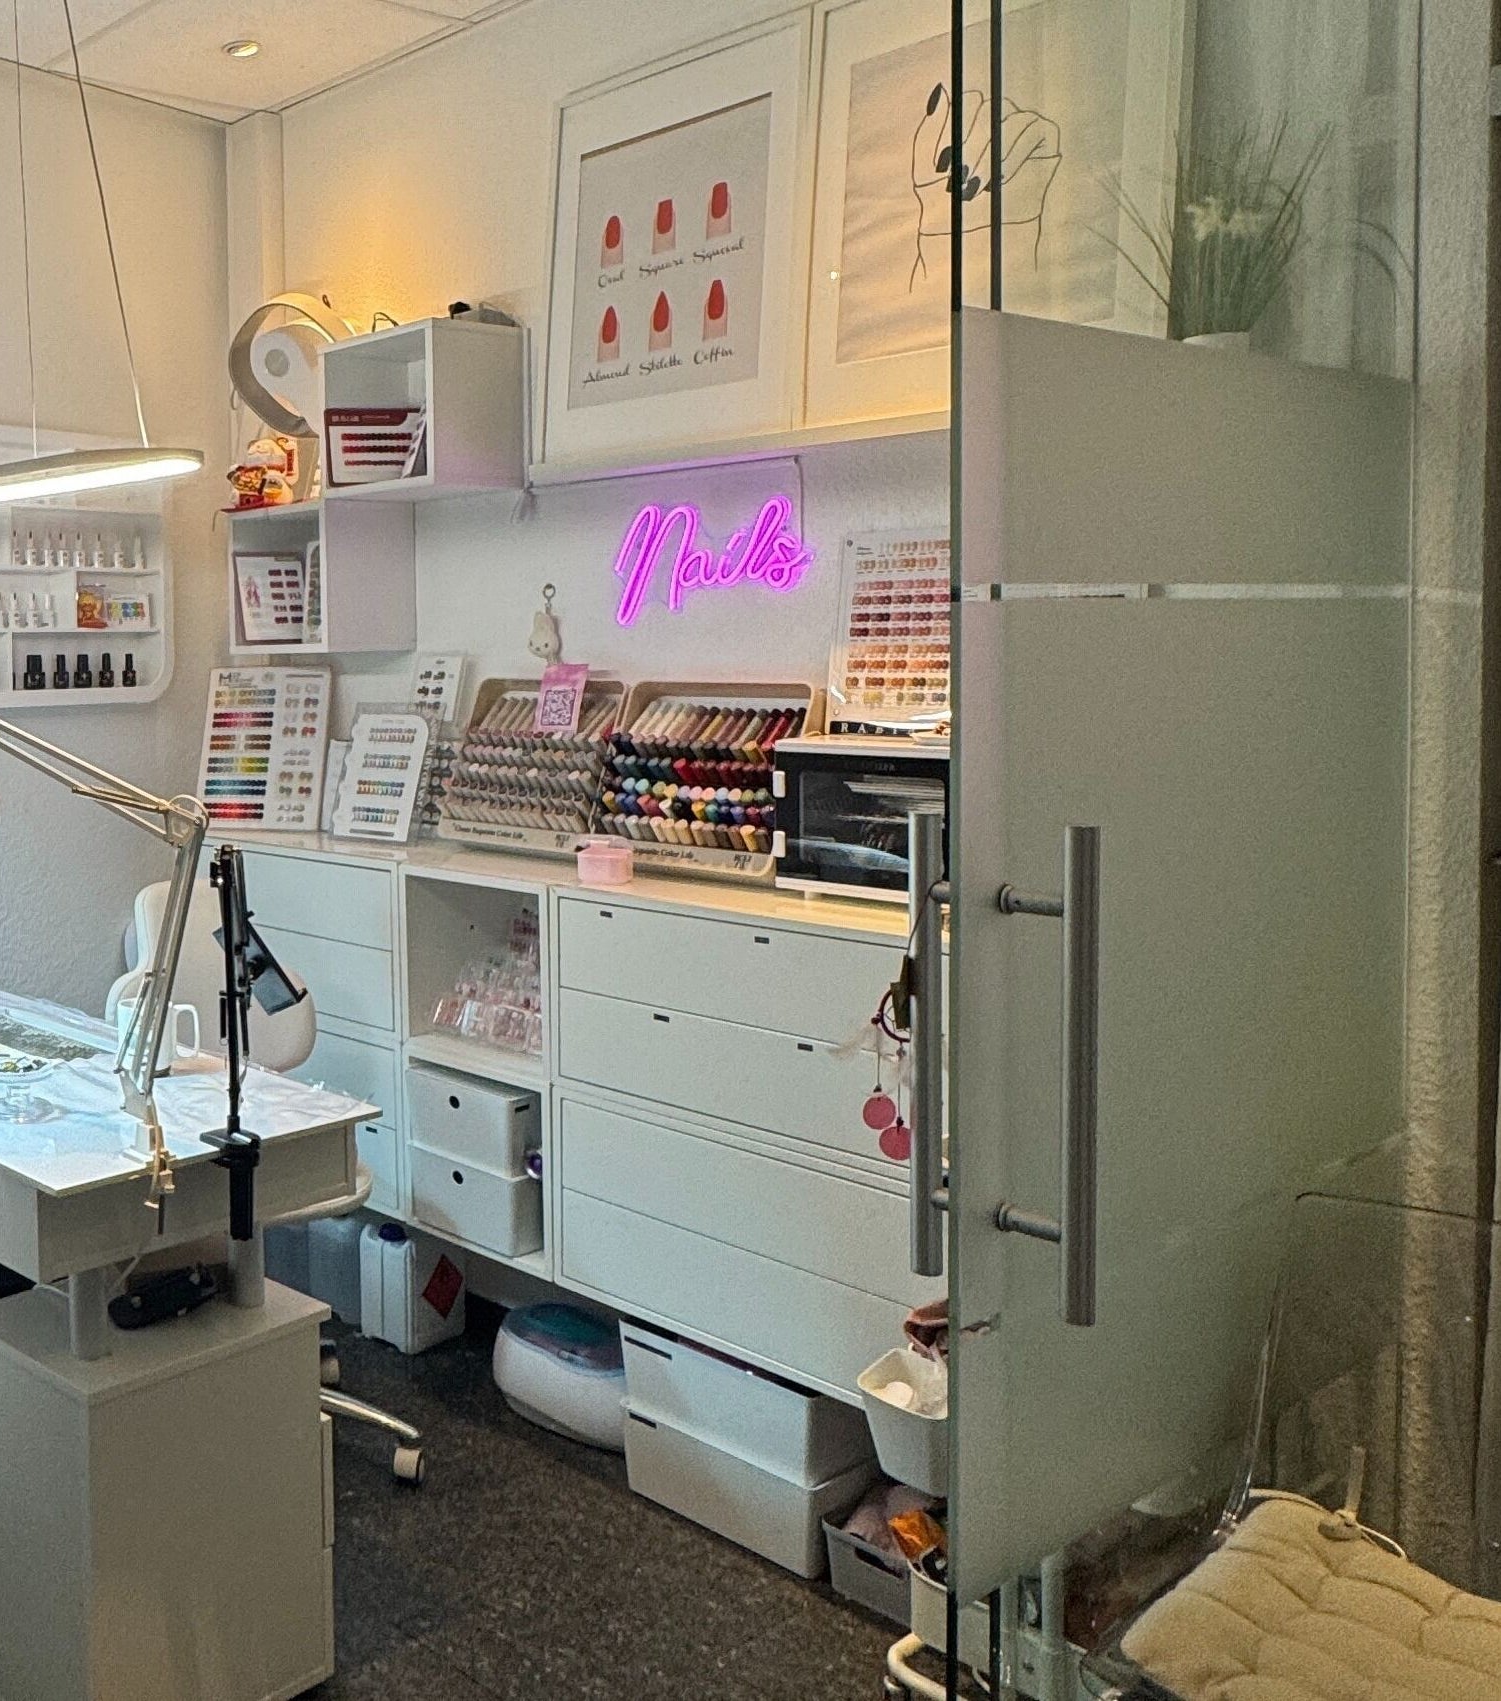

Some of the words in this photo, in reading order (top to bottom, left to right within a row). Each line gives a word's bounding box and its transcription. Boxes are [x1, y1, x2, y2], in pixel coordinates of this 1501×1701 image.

[638, 257, 684, 279] Square
[582, 366, 630, 387] Almond
[693, 346, 734, 365] Coffin
[615, 496, 813, 626] Nails
